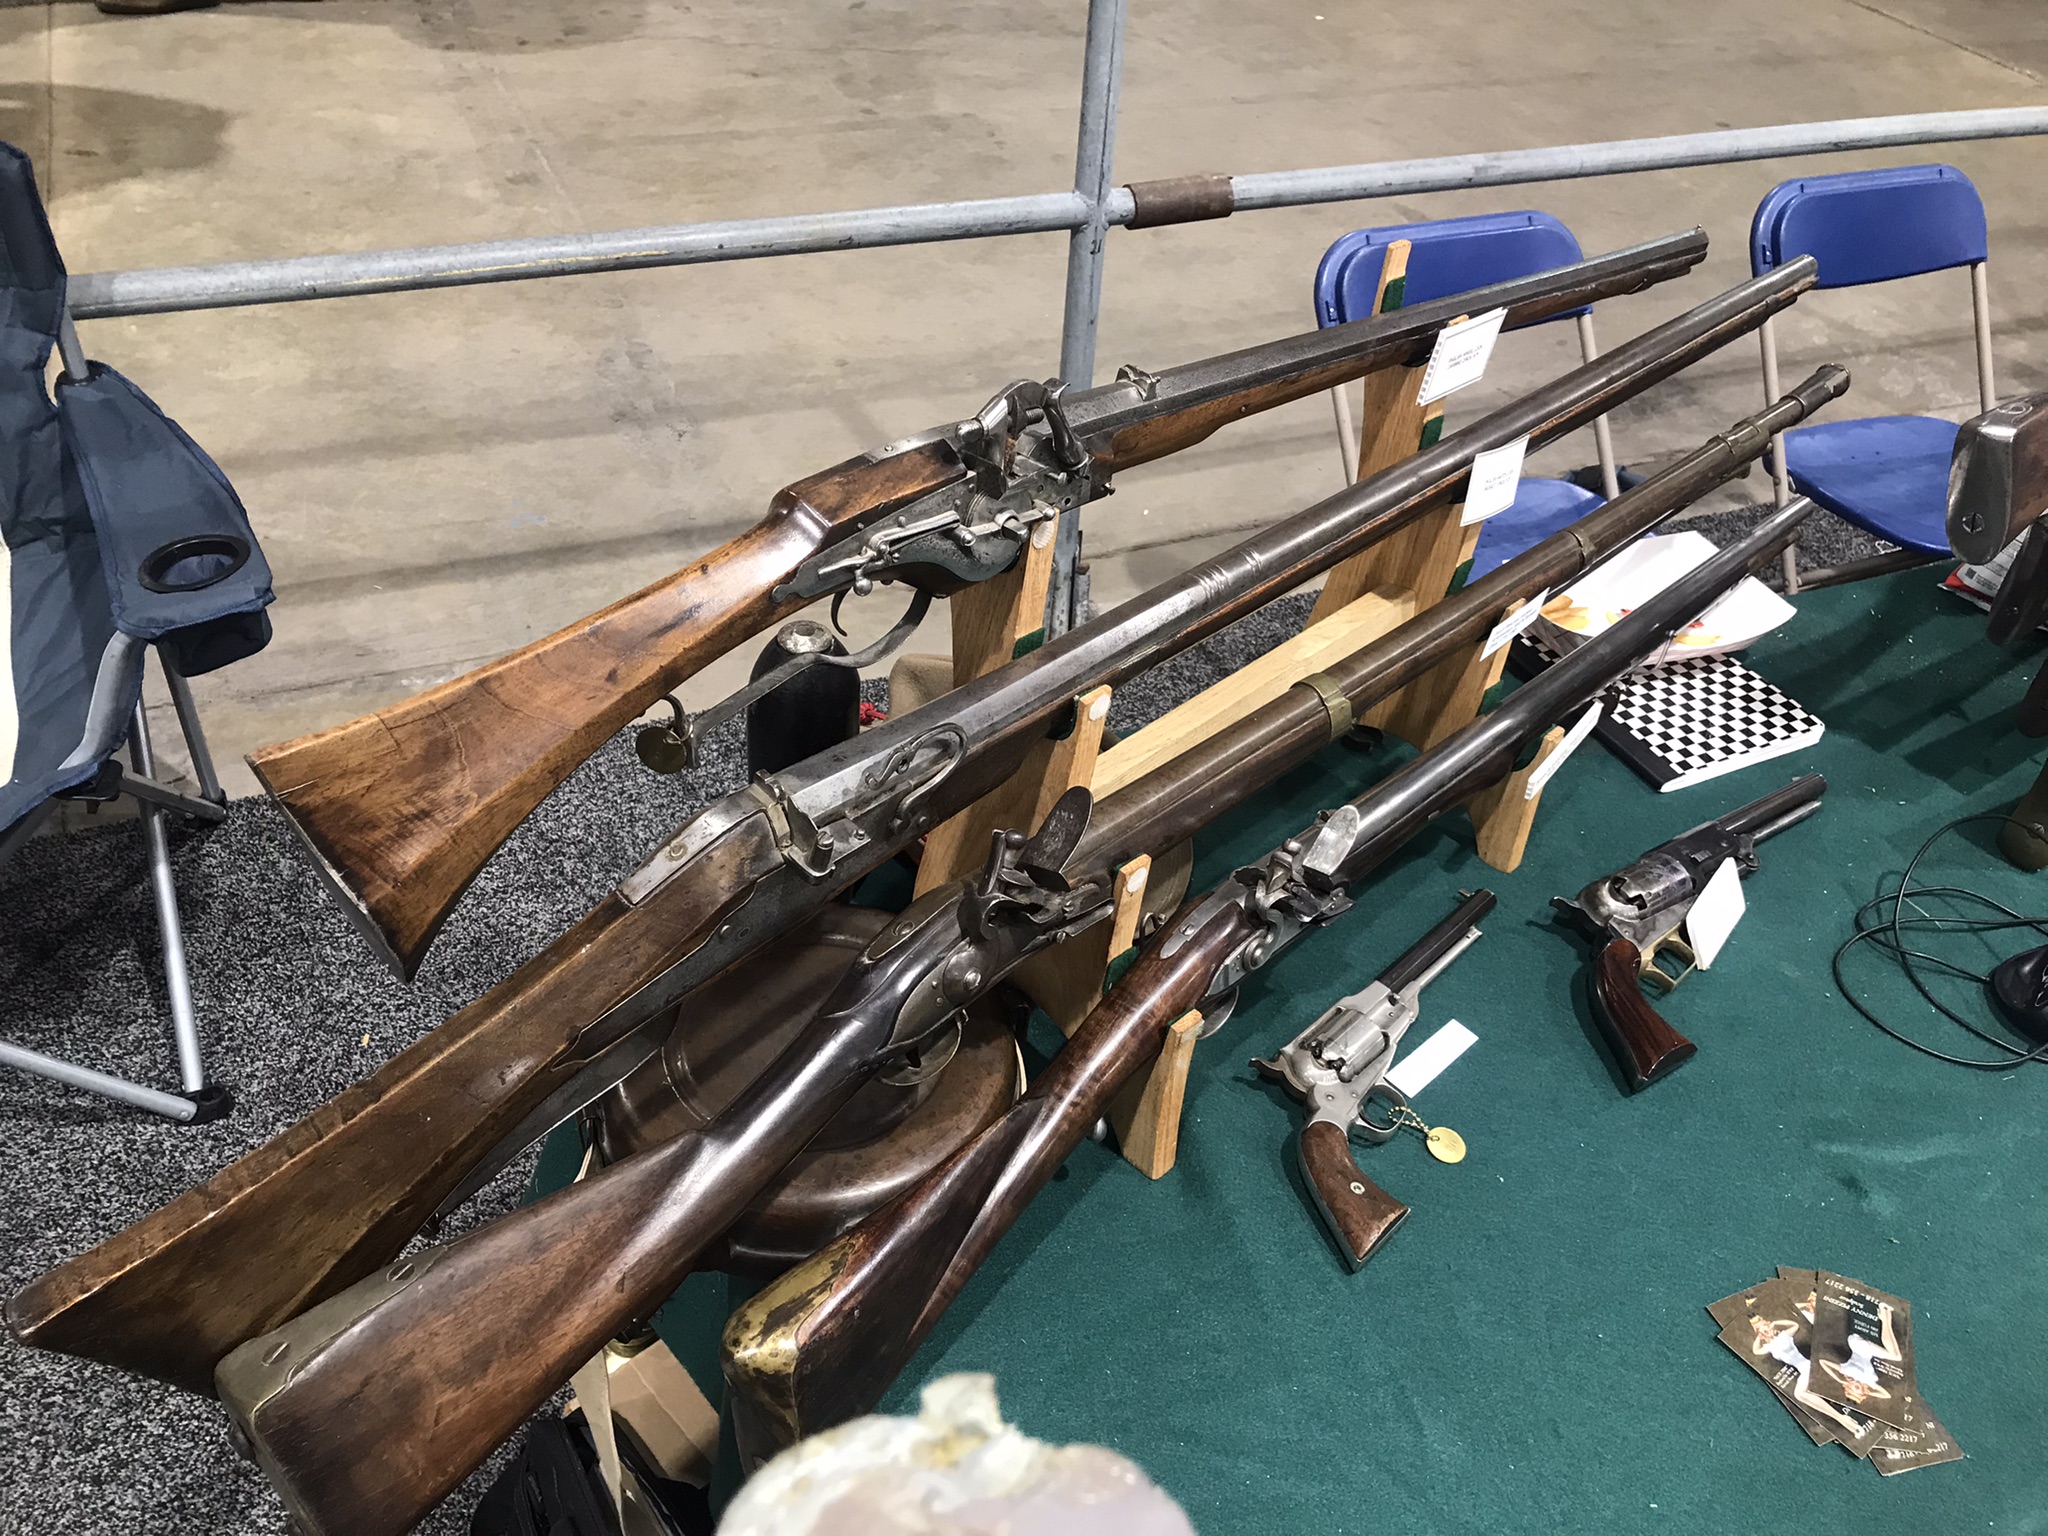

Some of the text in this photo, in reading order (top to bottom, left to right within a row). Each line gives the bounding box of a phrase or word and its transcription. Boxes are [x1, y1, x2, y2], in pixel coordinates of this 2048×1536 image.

[1825, 1279, 1844, 1290] 2217
[1839, 1295, 1865, 1309] Sculptor
[1865, 1295, 1880, 1305] 718
[1823, 1295, 1879, 1322] DENNY PIZZINI
[1900, 1434, 1918, 1443] 2217
